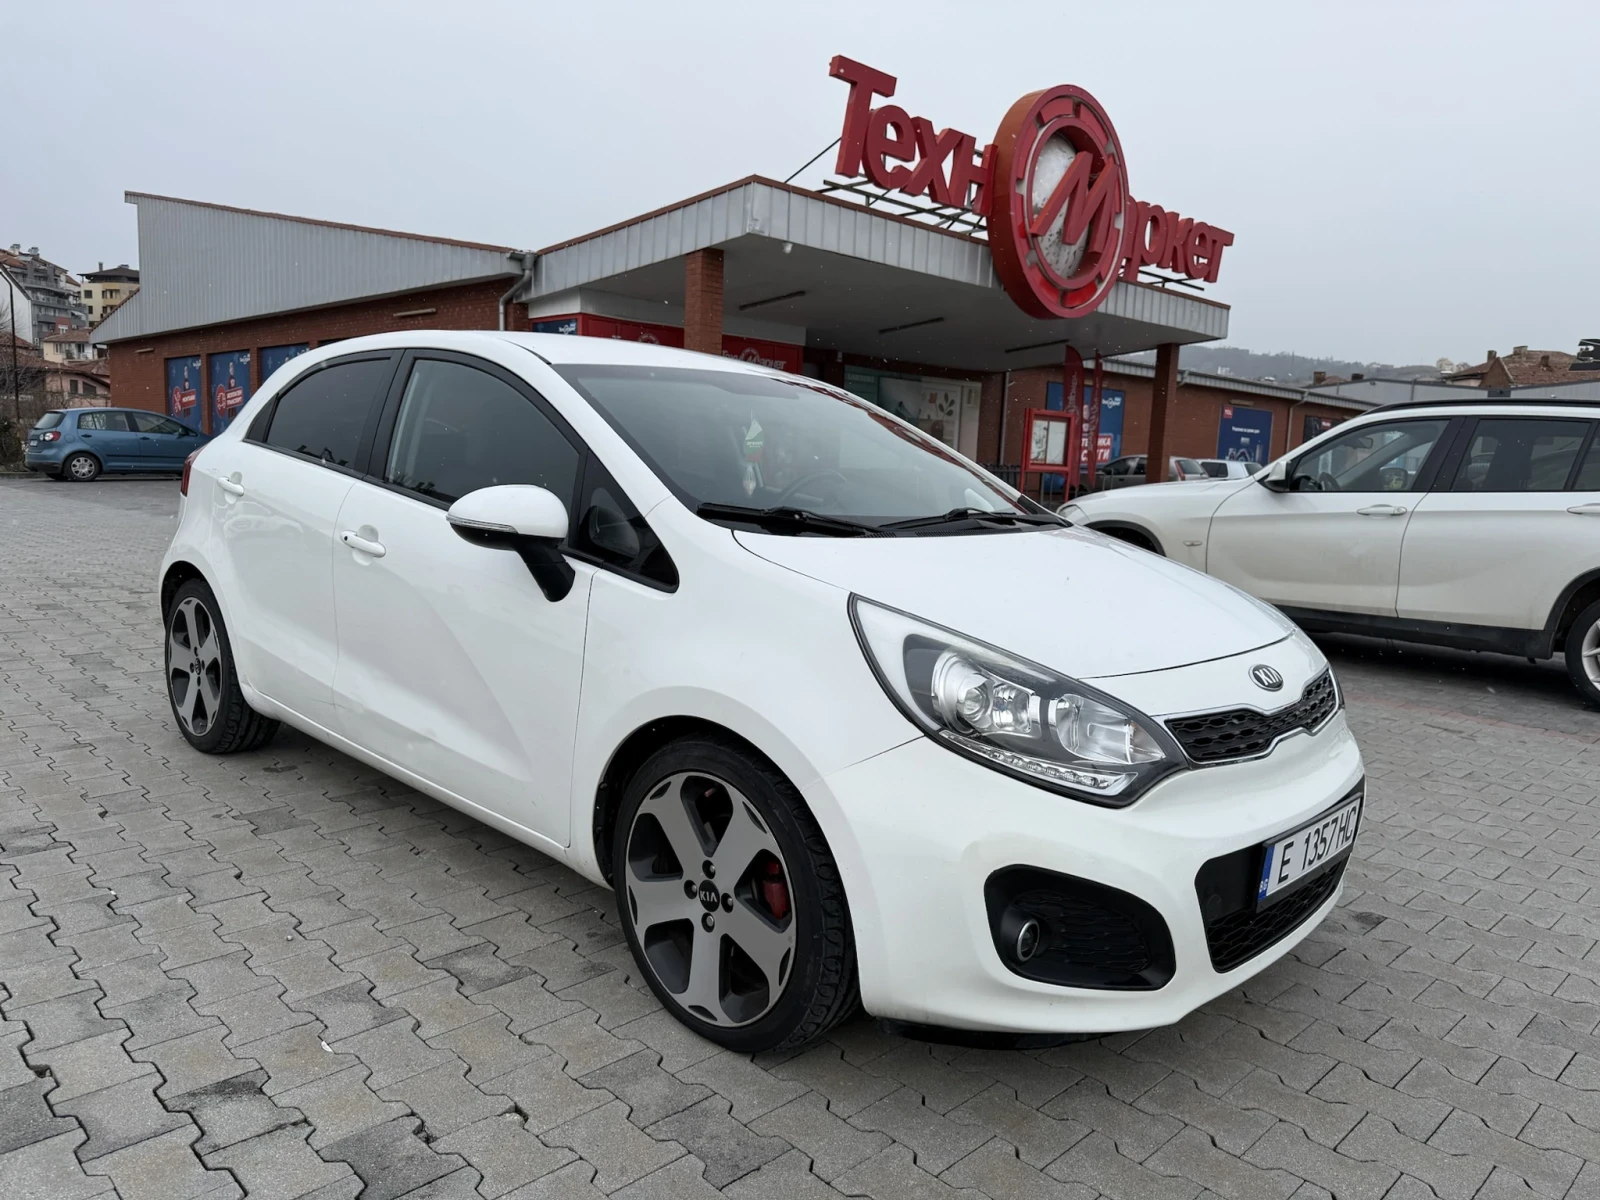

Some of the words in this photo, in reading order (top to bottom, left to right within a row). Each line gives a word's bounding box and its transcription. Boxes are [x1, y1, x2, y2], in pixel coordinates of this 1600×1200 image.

[1254, 667, 1283, 686] KIA
[1278, 841, 1294, 884] E
[700, 890, 718, 903] KIA
